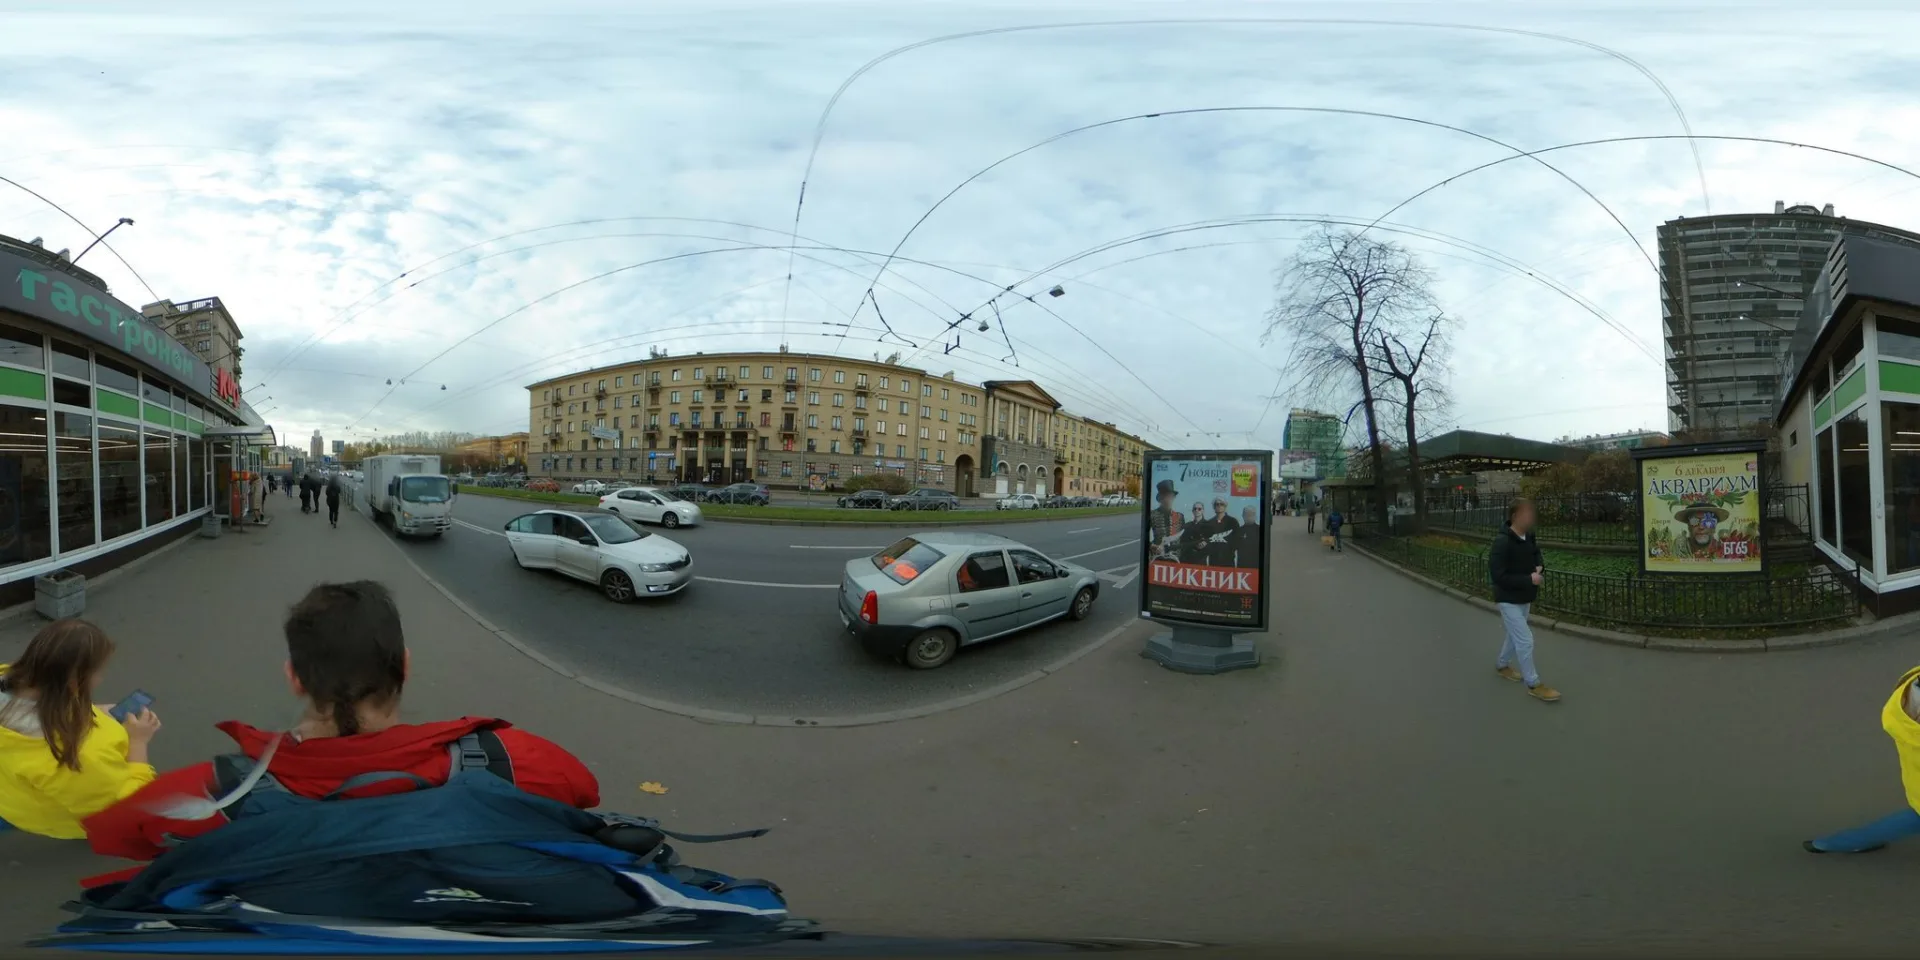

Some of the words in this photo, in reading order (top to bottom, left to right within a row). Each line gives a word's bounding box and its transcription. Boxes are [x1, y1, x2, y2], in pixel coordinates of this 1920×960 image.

[21, 269, 193, 379] гастроном
[1179, 463, 1188, 482] 7
[1189, 469, 1228, 478] НОЯБРЯ
[1675, 465, 1682, 476] 6
[1685, 466, 1725, 476] ДЕКАБРЯ
[1648, 475, 1757, 495] АКВАРИУМ
[1153, 564, 1252, 591] ПИКНИК
